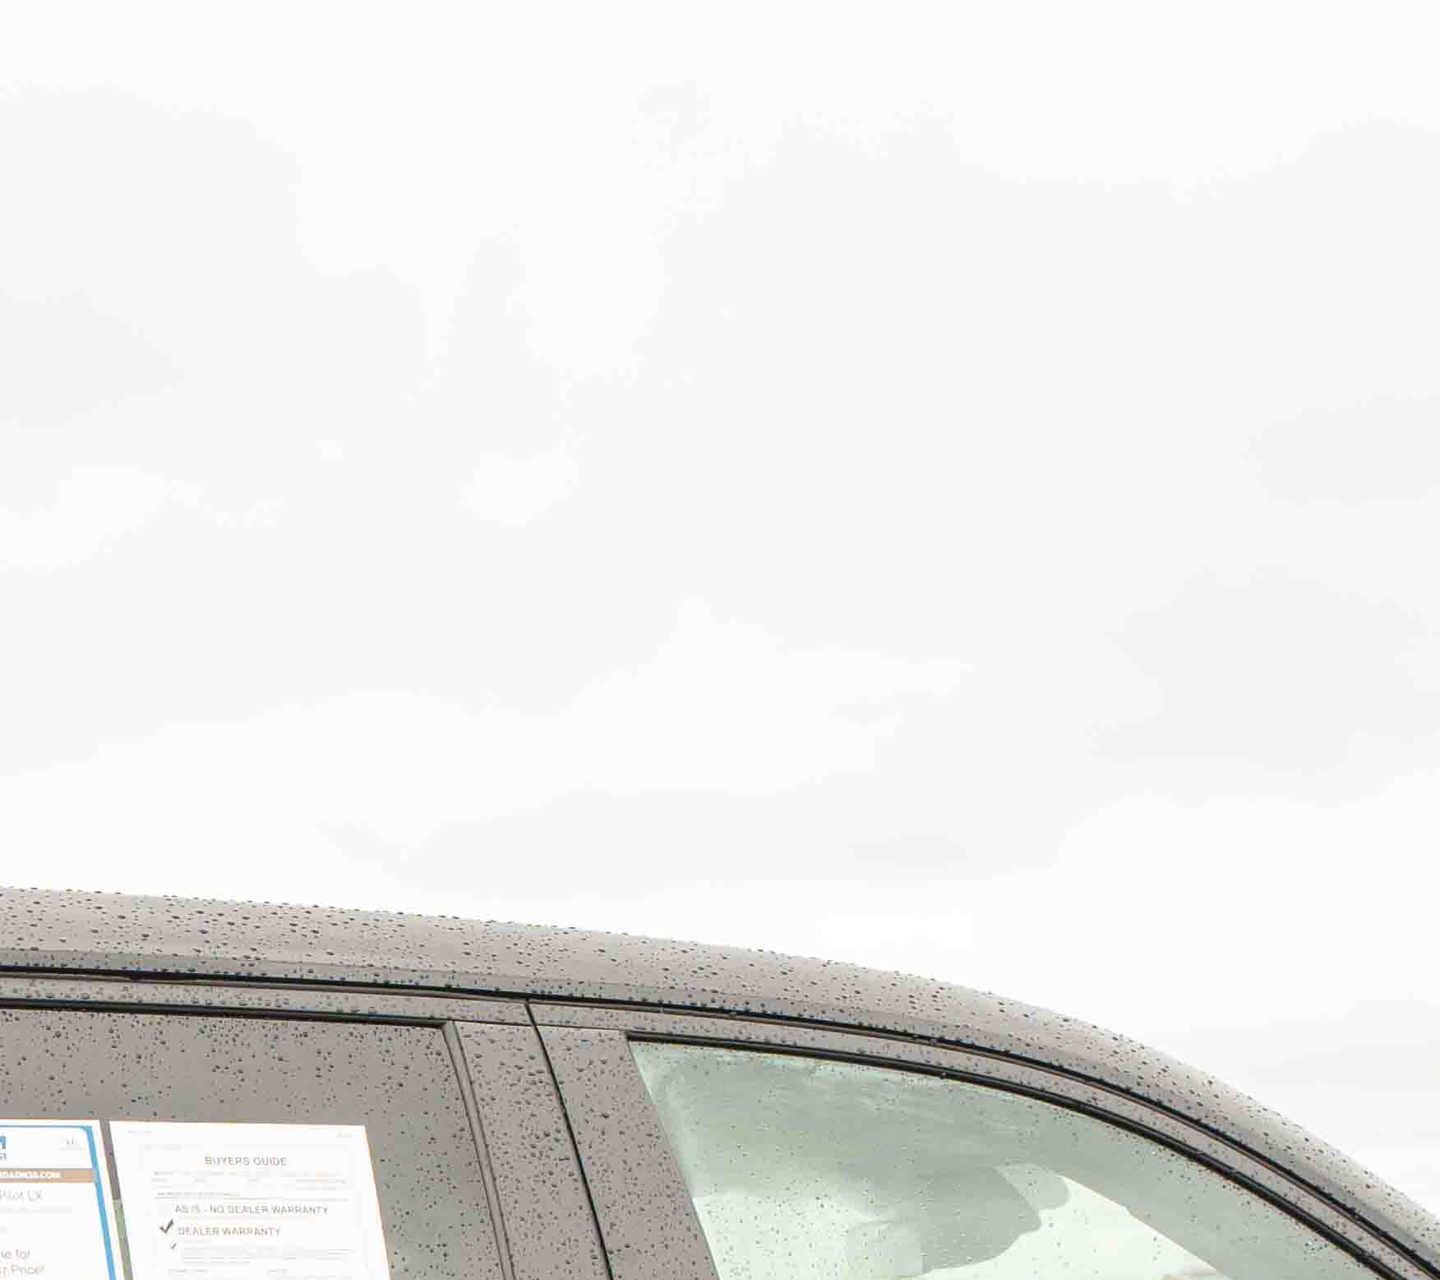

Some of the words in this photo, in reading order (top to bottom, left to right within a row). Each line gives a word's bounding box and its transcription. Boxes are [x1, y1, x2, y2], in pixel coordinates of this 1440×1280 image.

[204, 1155, 250, 1167] BUYERS
[253, 1155, 288, 1167] GUIDE
[228, 1204, 269, 1214] DEALER
[271, 1205, 328, 1215] WARRANTY
[177, 1226, 220, 1236] DEALER
[222, 1226, 281, 1237] WARRANTY
